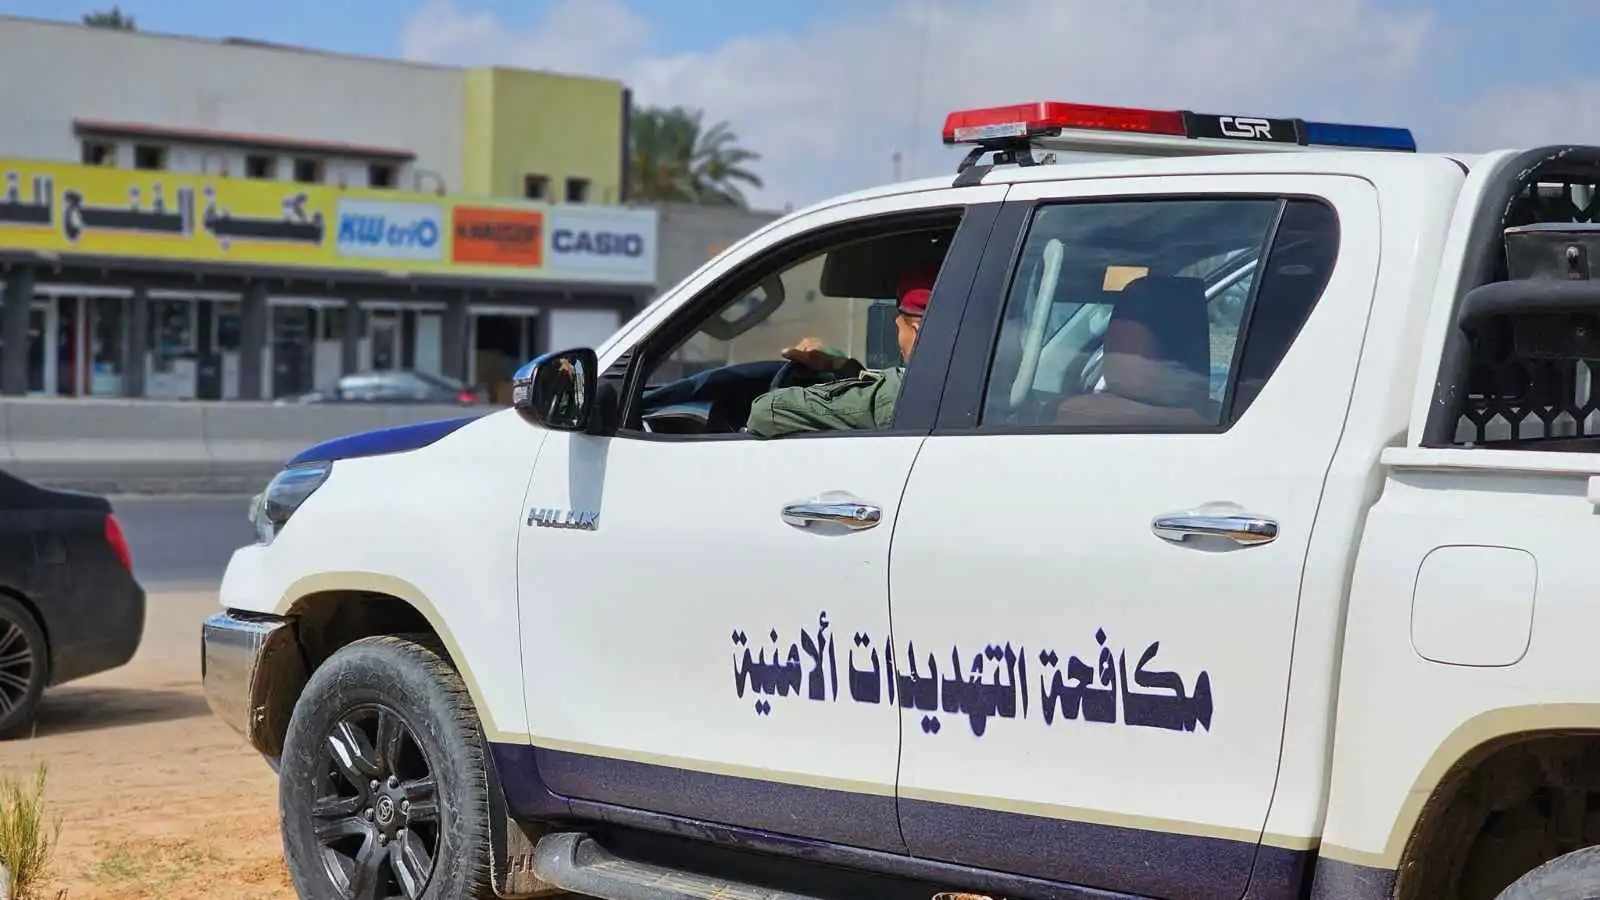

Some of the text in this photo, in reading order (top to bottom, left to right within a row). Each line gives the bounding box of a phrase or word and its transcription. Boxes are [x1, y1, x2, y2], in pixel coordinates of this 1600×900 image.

[1219, 116, 1273, 139] CSR
[551, 229, 644, 258] CASIO
[527, 507, 600, 531] HILUX
[848, 631, 1029, 738] التهديدات
[1038, 627, 1214, 733] مكافحة
